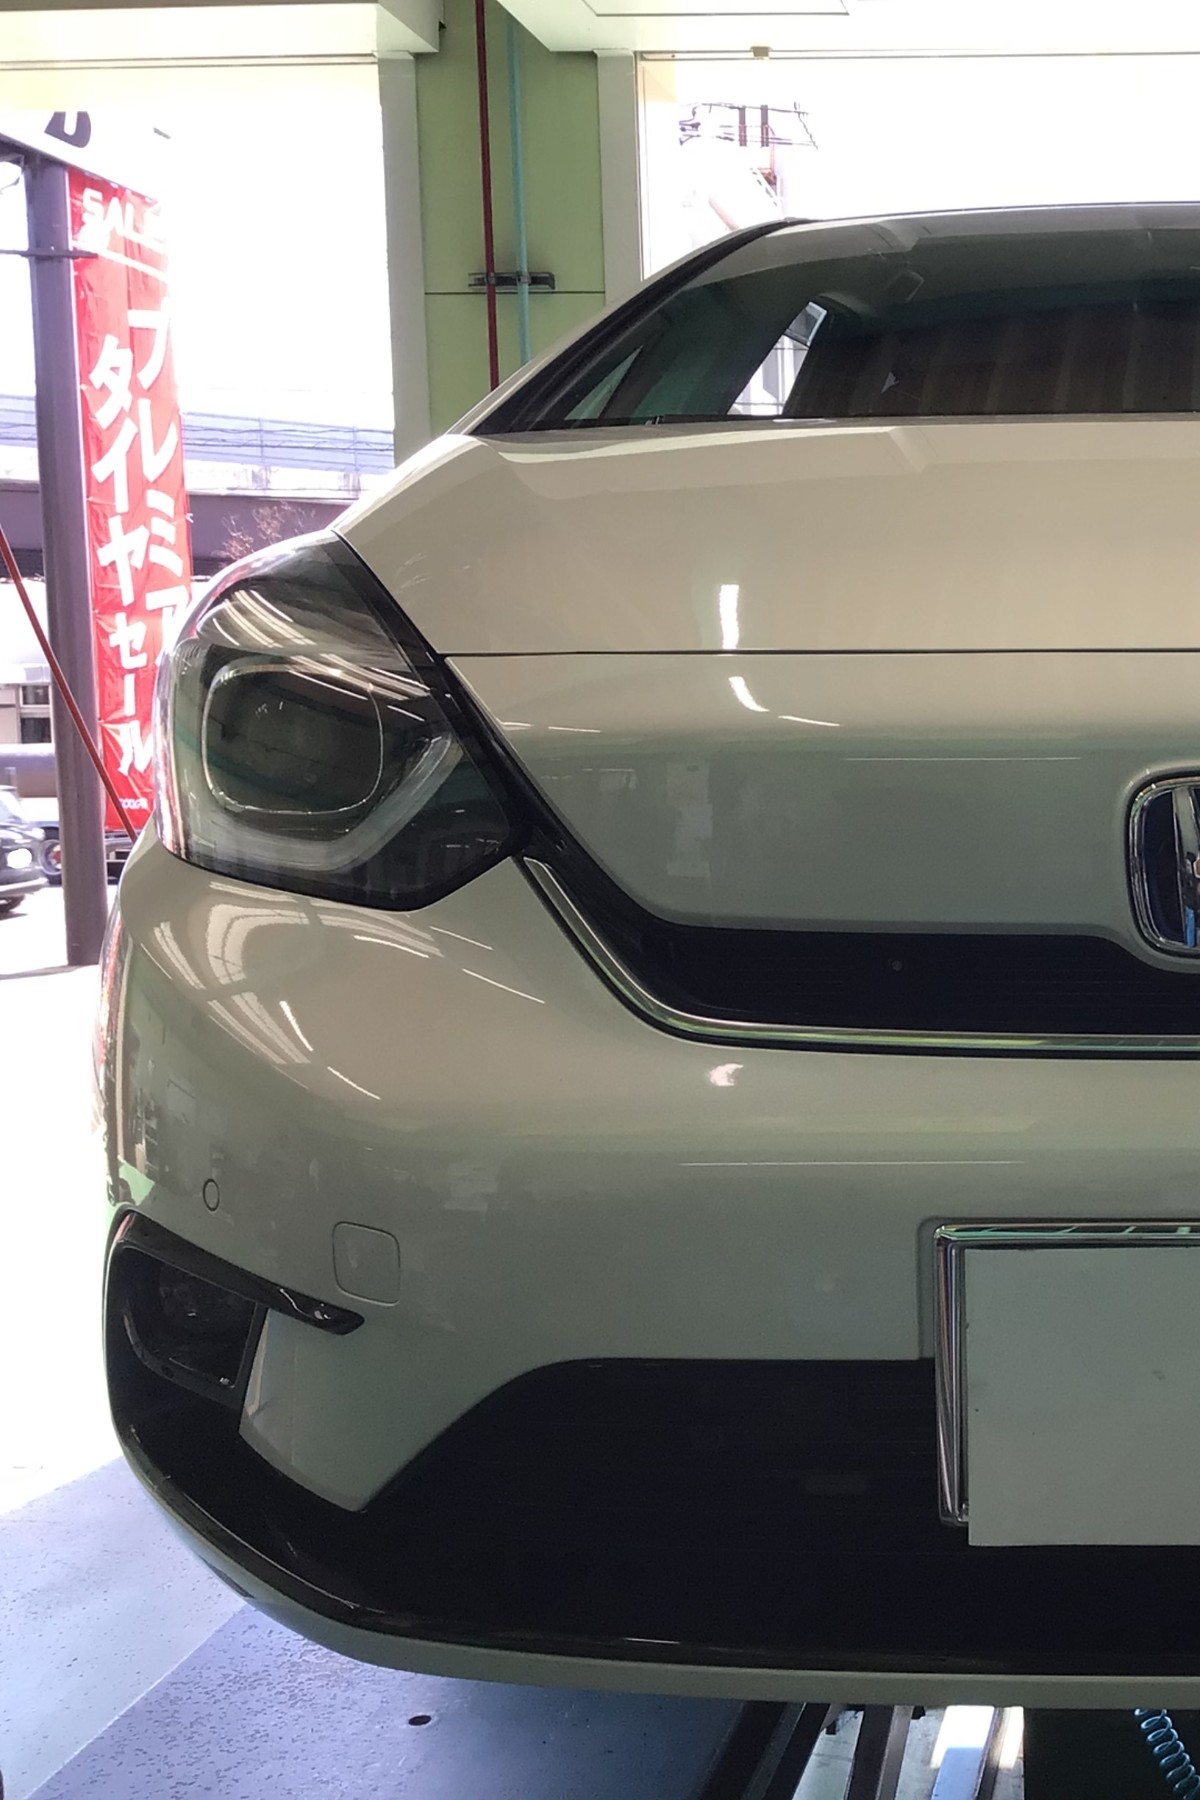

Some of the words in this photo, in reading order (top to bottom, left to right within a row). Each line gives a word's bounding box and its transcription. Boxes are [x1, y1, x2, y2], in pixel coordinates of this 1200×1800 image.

[89, 334, 153, 776] タイヤセール
